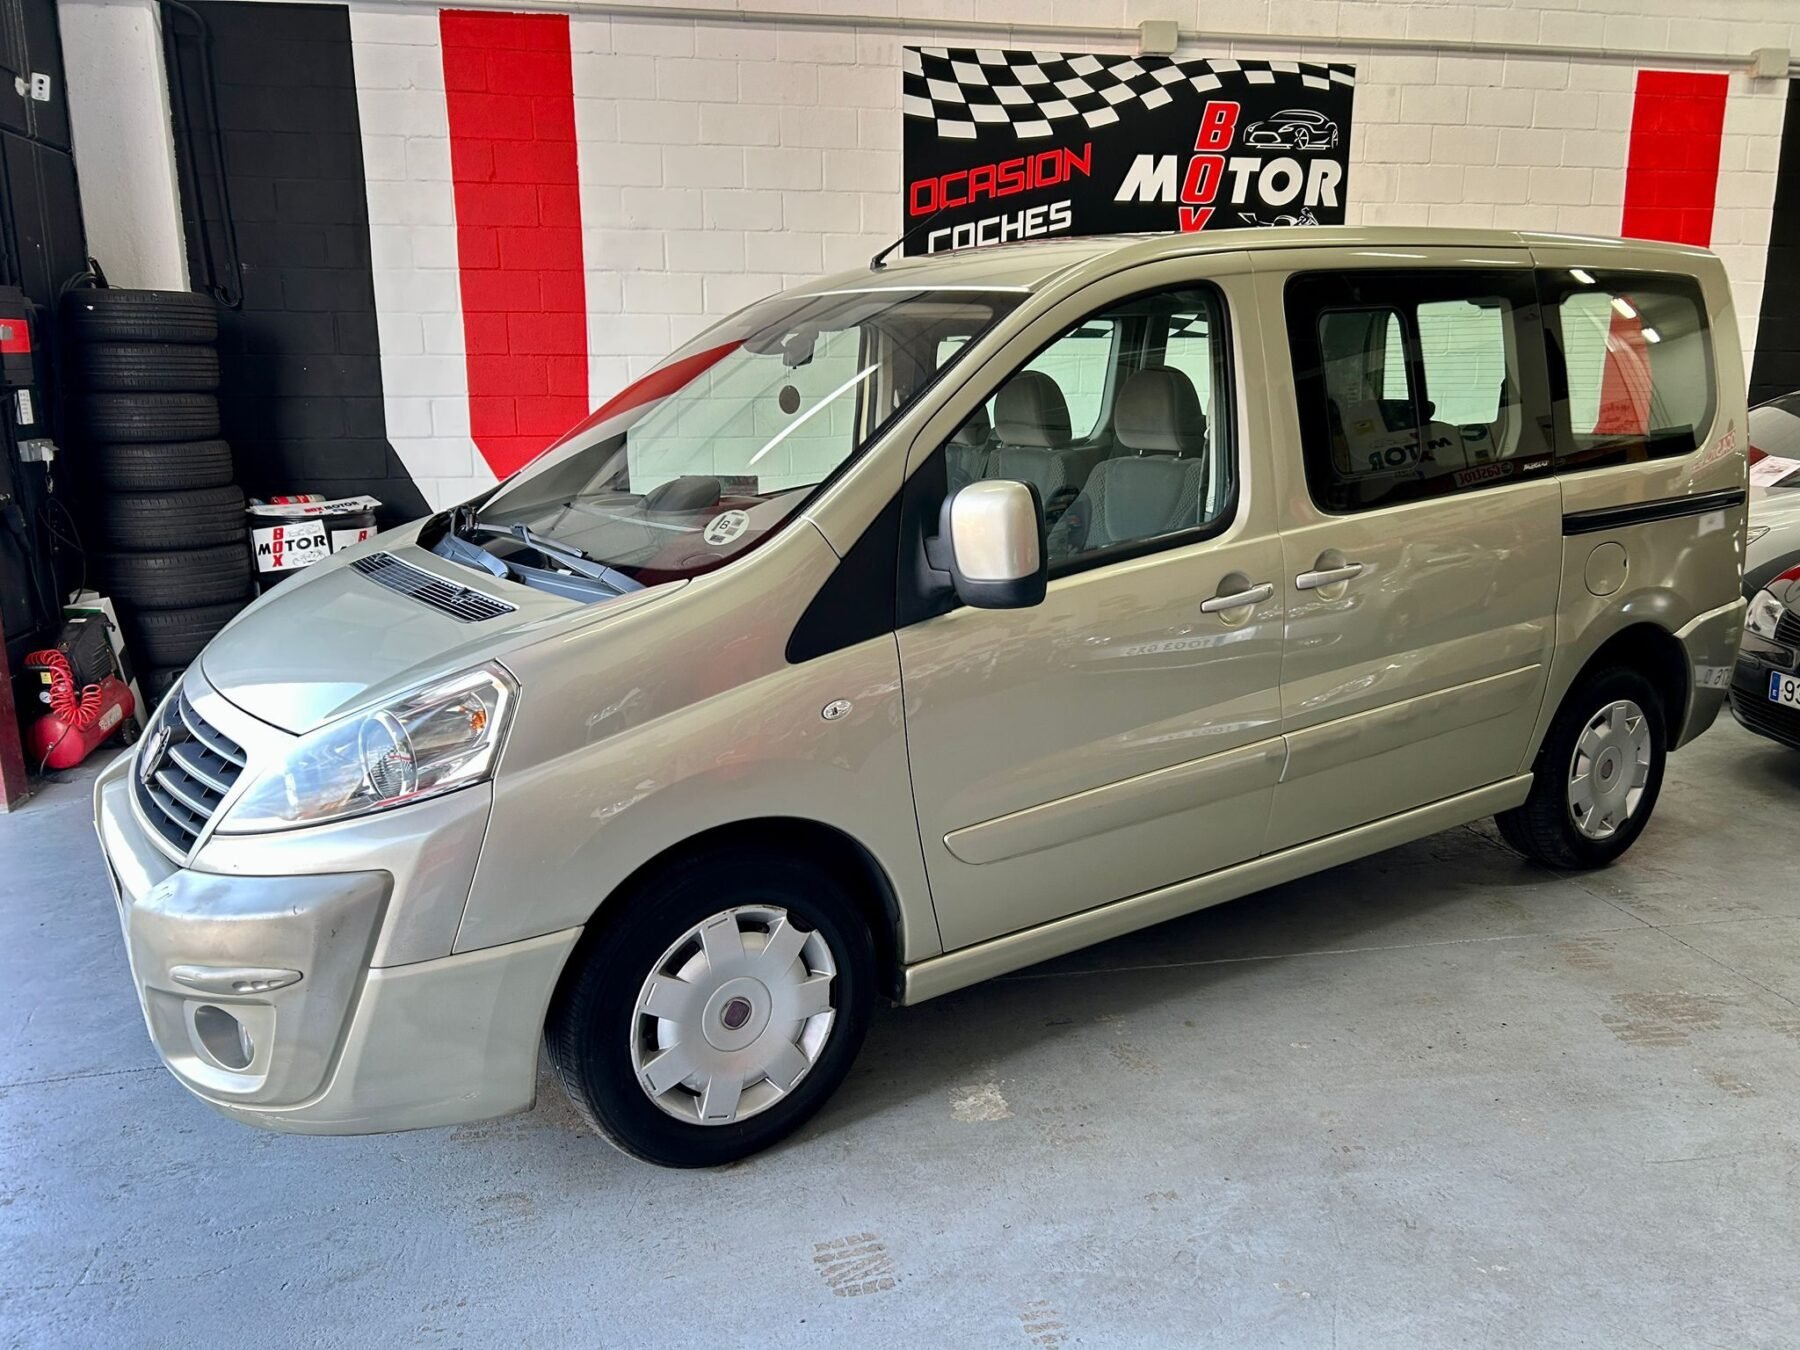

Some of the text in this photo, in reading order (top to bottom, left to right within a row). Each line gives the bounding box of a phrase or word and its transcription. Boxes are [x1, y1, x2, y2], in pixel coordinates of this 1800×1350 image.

[910, 142, 1092, 216] OCASION
[928, 199, 1072, 254] COCHES
[257, 534, 327, 556] MOTOR
[272, 527, 284, 568] BOX
